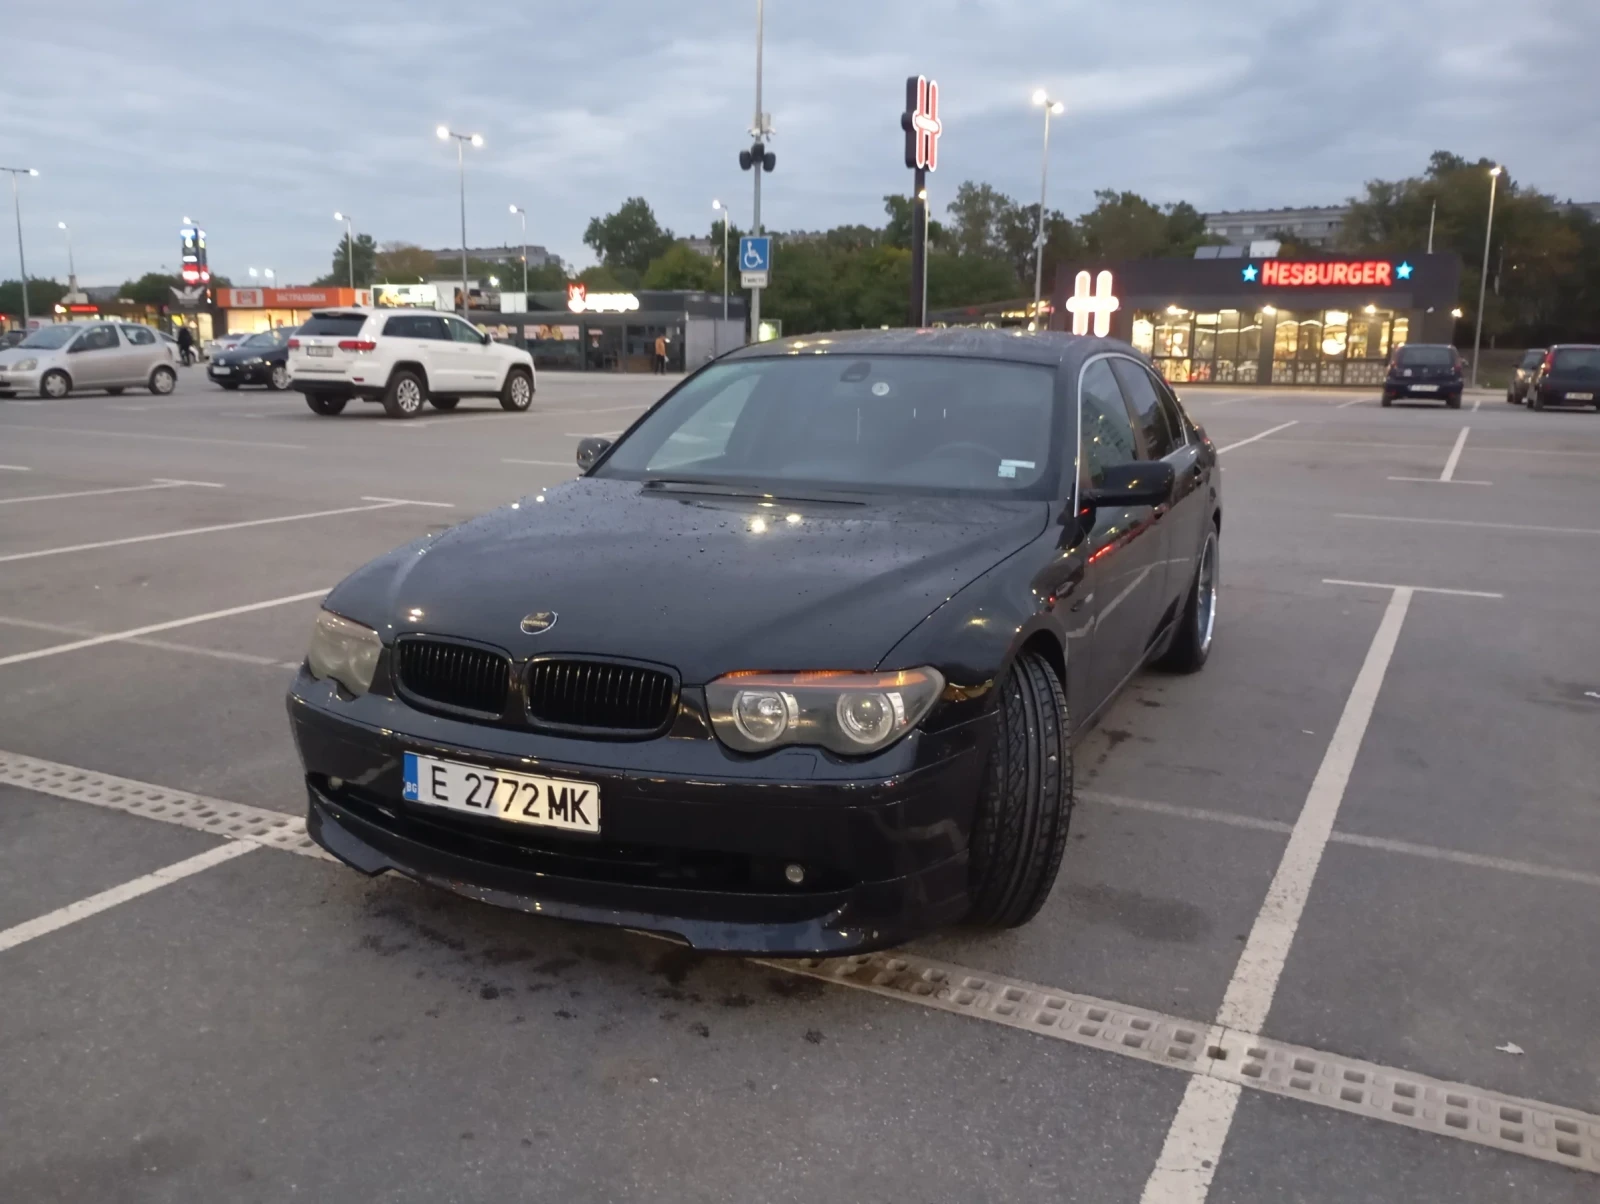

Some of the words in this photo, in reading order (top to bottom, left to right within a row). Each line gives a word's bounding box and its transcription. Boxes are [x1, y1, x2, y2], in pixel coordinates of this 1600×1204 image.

[1262, 261, 1391, 286] HESBURGER
[406, 782, 417, 794] BG
[431, 765, 448, 801] E
[465, 773, 540, 818] 2772
[547, 785, 591, 825] MK
